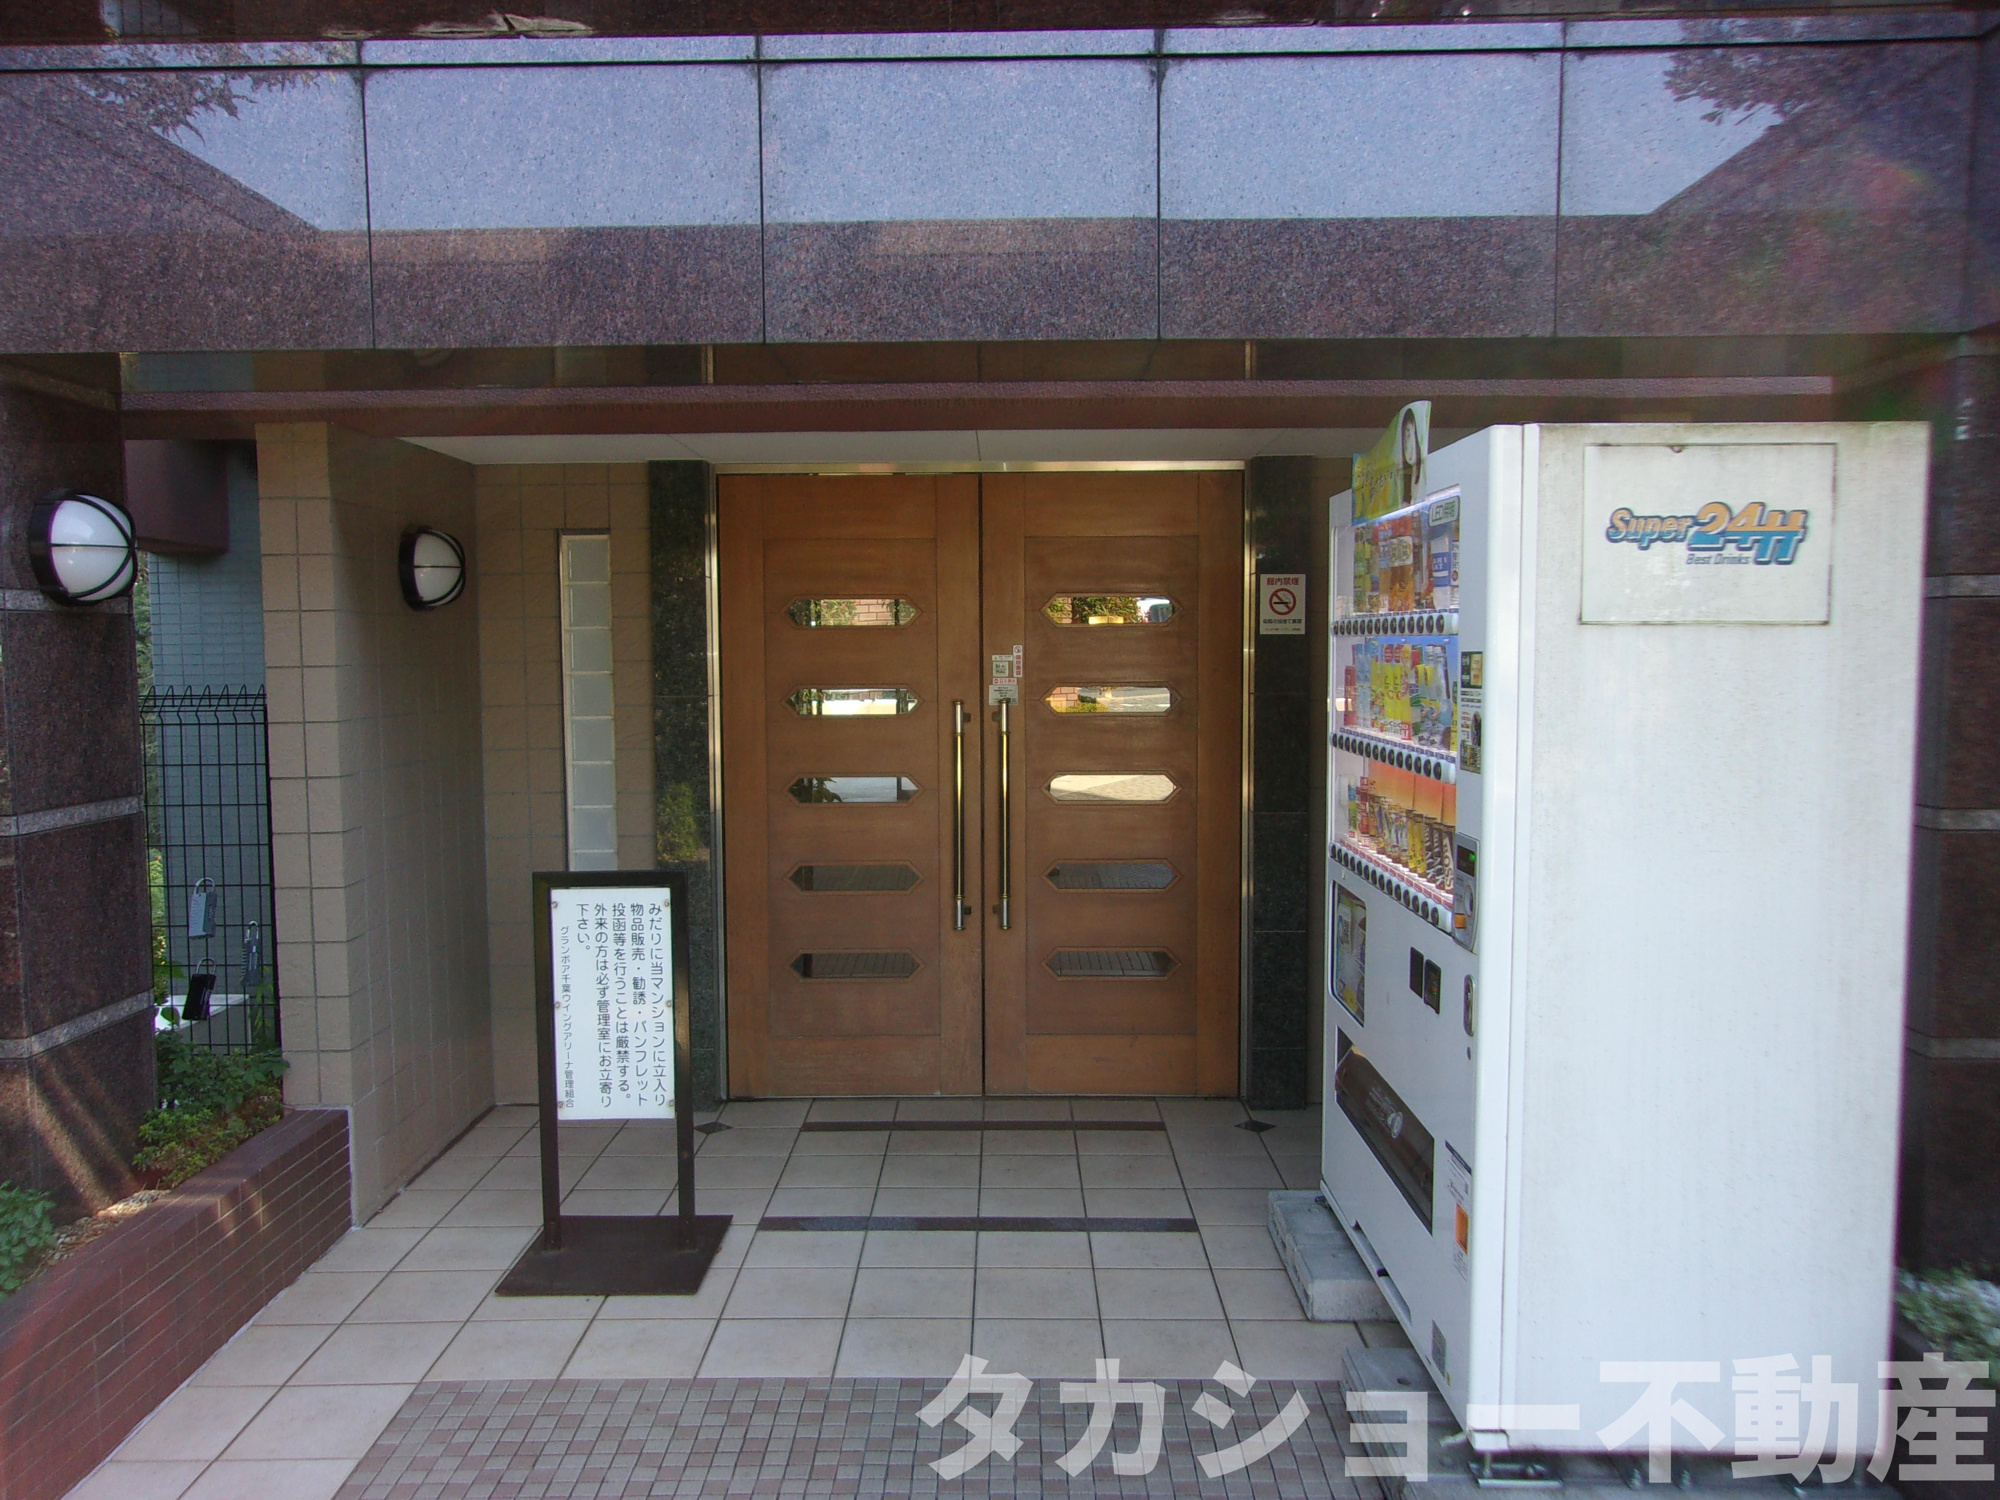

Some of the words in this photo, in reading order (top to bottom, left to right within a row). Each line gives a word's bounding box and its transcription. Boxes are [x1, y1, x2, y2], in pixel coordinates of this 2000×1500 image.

[1686, 553, 1711, 565] Best
[1713, 553, 1750, 565] Drinks
[576, 903, 591, 952] 下さい。
[594, 902, 613, 1108] 外来の方は必ず管理室にお立寄り
[612, 902, 631, 1101] 投函等を行うことは厳禁する。
[630, 902, 648, 1107] 物品販売・勧誘・パンフレット
[648, 902, 666, 1107] みだりに当マンションに立入り
